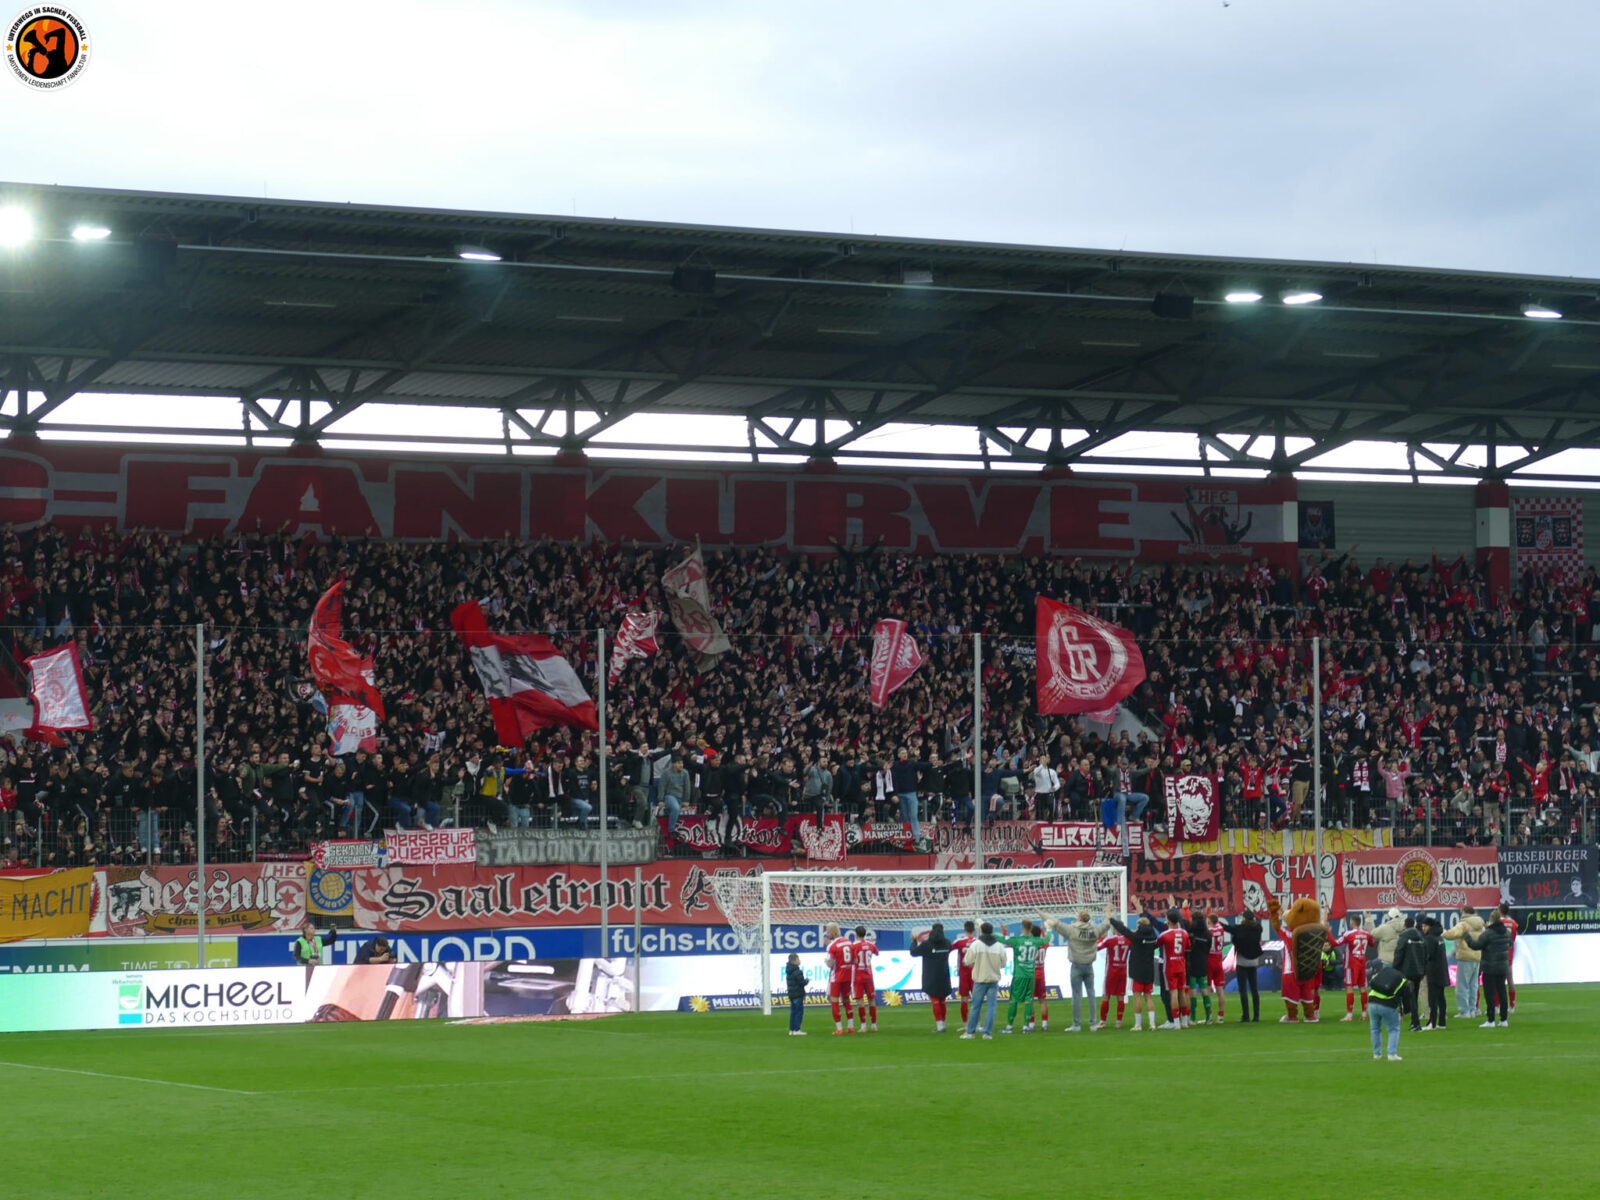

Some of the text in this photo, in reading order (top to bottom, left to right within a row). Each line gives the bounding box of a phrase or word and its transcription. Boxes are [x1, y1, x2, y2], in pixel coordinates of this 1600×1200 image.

[1498, 849, 1588, 863] MERSEBURGER
[273, 865, 307, 877] HFC
[1346, 858, 1498, 888] Leuna Löwen
[1506, 861, 1580, 876] DOMFALKEN
[382, 872, 671, 921] Saalefront
[1378, 889, 1468, 905] seit 1984
[1526, 879, 1561, 901] 1982
[12, 882, 89, 921] MACHT
[1536, 923, 1547, 931] FÜR
[1174, 937, 1183, 954] 5
[1211, 936, 1225, 951] 13
[843, 946, 852, 963] 6
[858, 950, 873, 967] 16
[1018, 945, 1036, 963] 30
[1113, 944, 1129, 961] 17
[712, 997, 762, 1008] MERKUR
[145, 1007, 293, 1024] DAS KOCHSTUDIO
